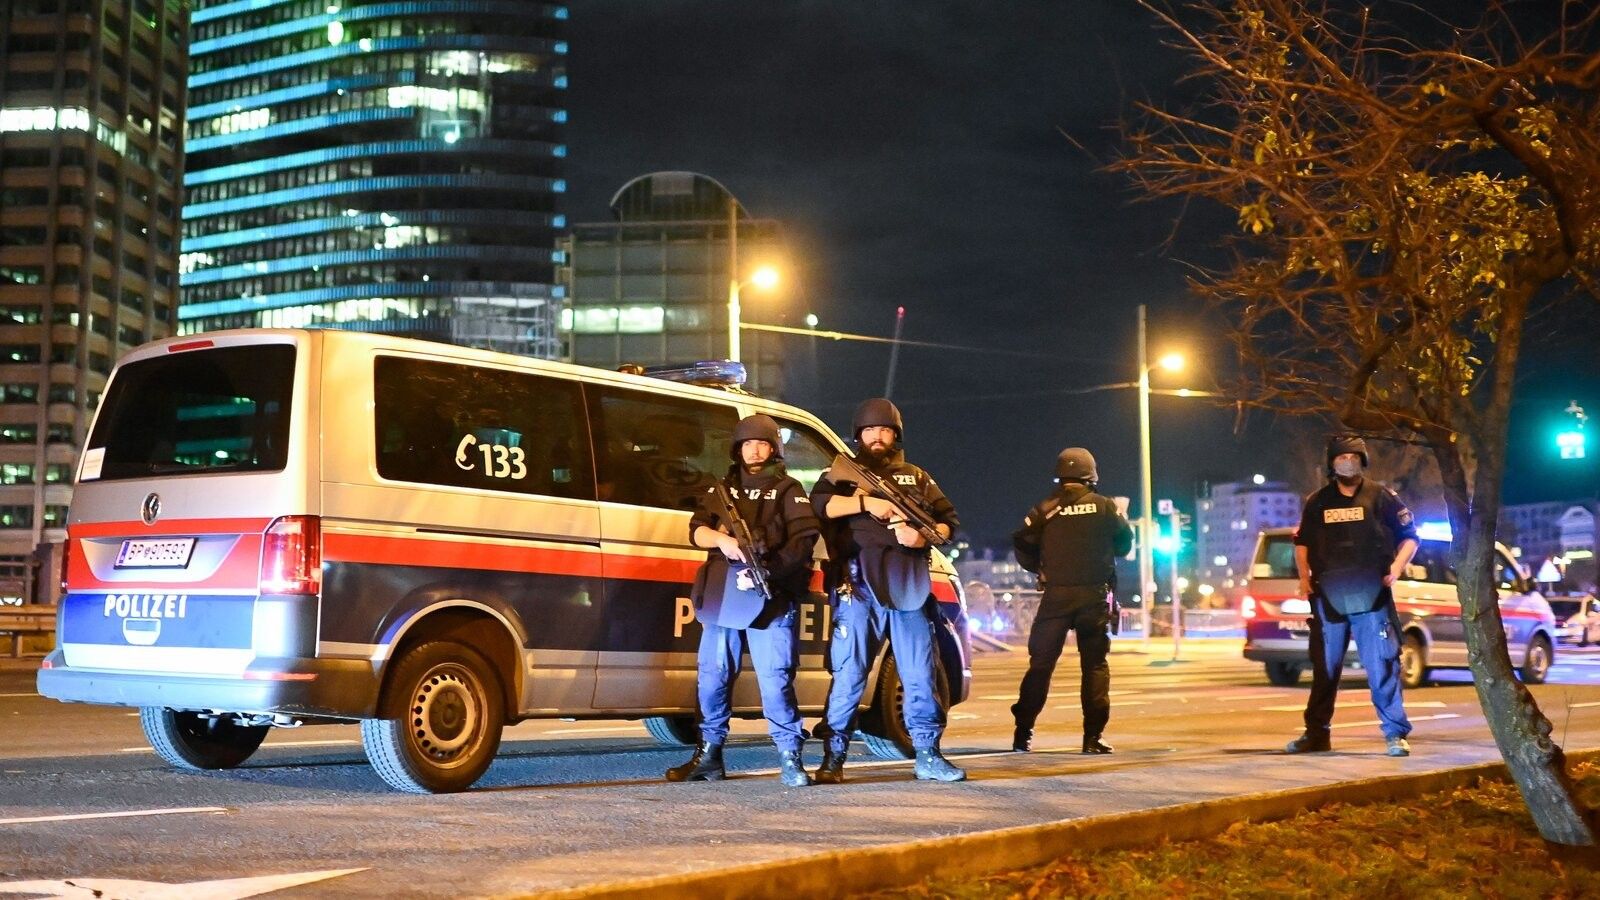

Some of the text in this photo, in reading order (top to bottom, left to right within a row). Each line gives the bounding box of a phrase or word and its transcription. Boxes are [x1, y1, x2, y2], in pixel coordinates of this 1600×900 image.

[478, 443, 527, 480] 133
[1325, 508, 1363, 521] POLIZEI
[104, 594, 188, 618] POLIZEI
